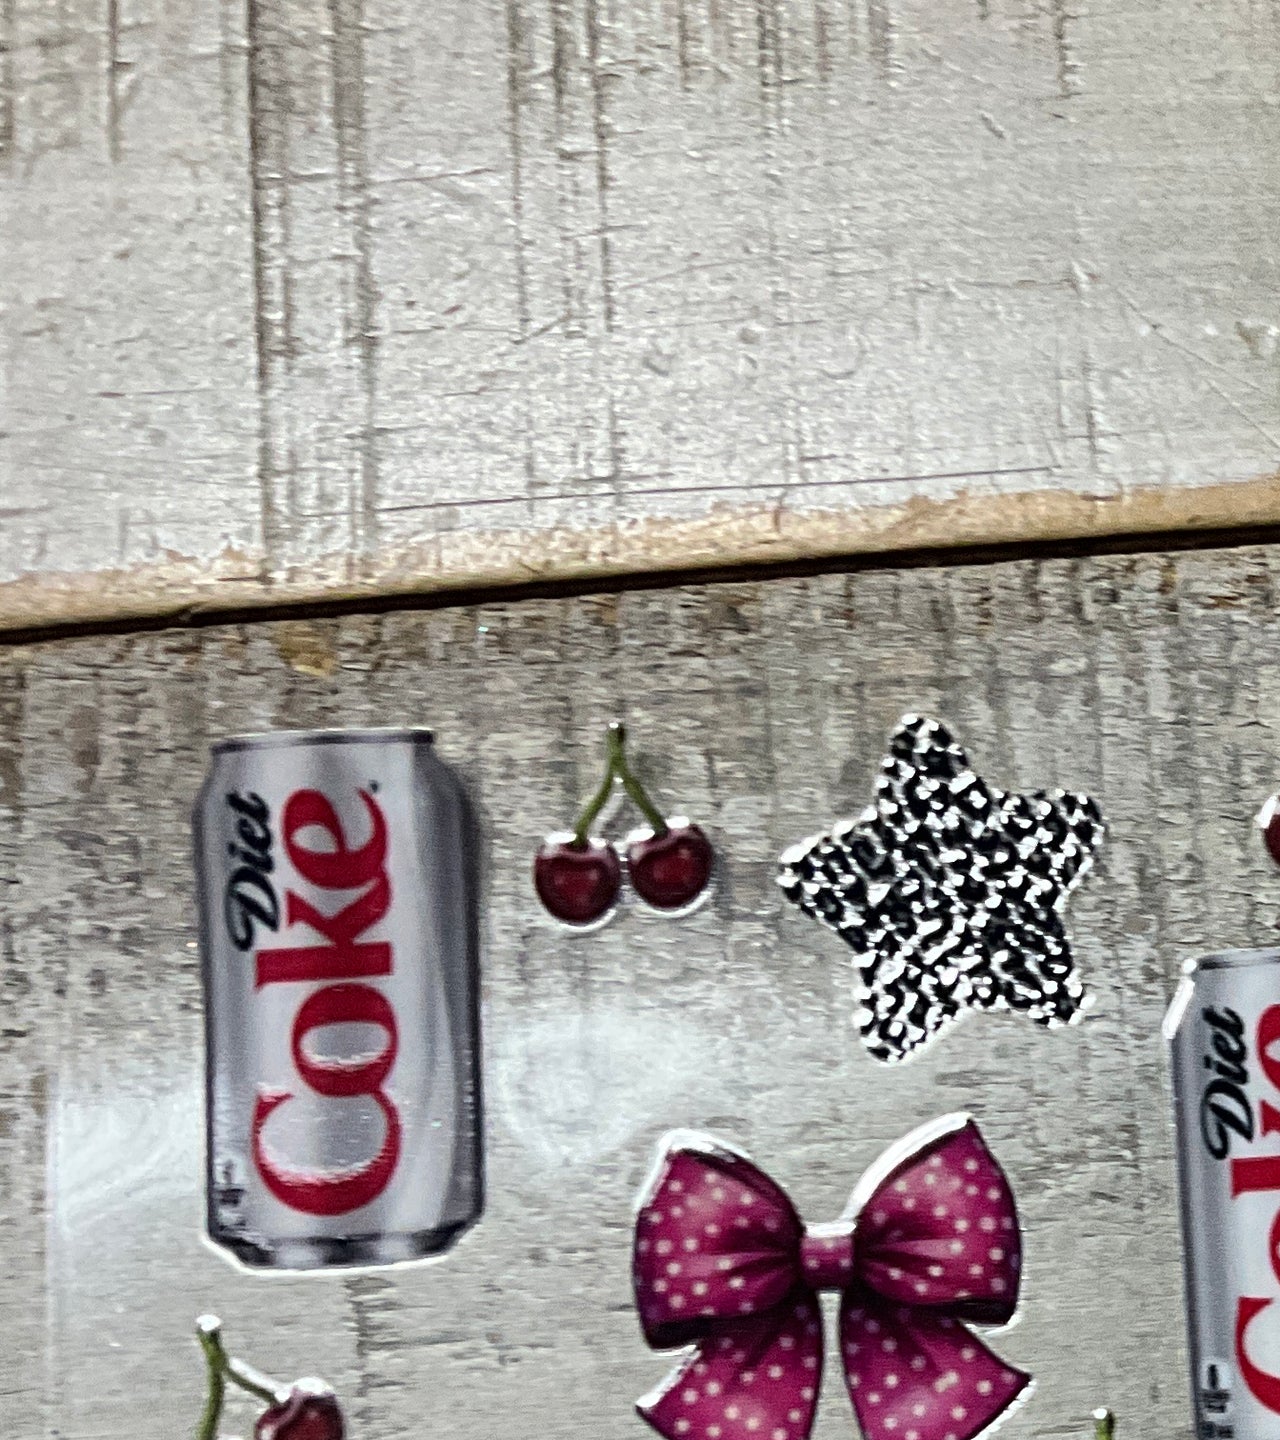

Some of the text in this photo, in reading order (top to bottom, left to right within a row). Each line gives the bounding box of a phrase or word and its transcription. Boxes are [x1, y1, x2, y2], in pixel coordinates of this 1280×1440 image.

[225, 789, 278, 952] Diet
[251, 786, 402, 1217] Coke
[1202, 1005, 1254, 1160] Diet
